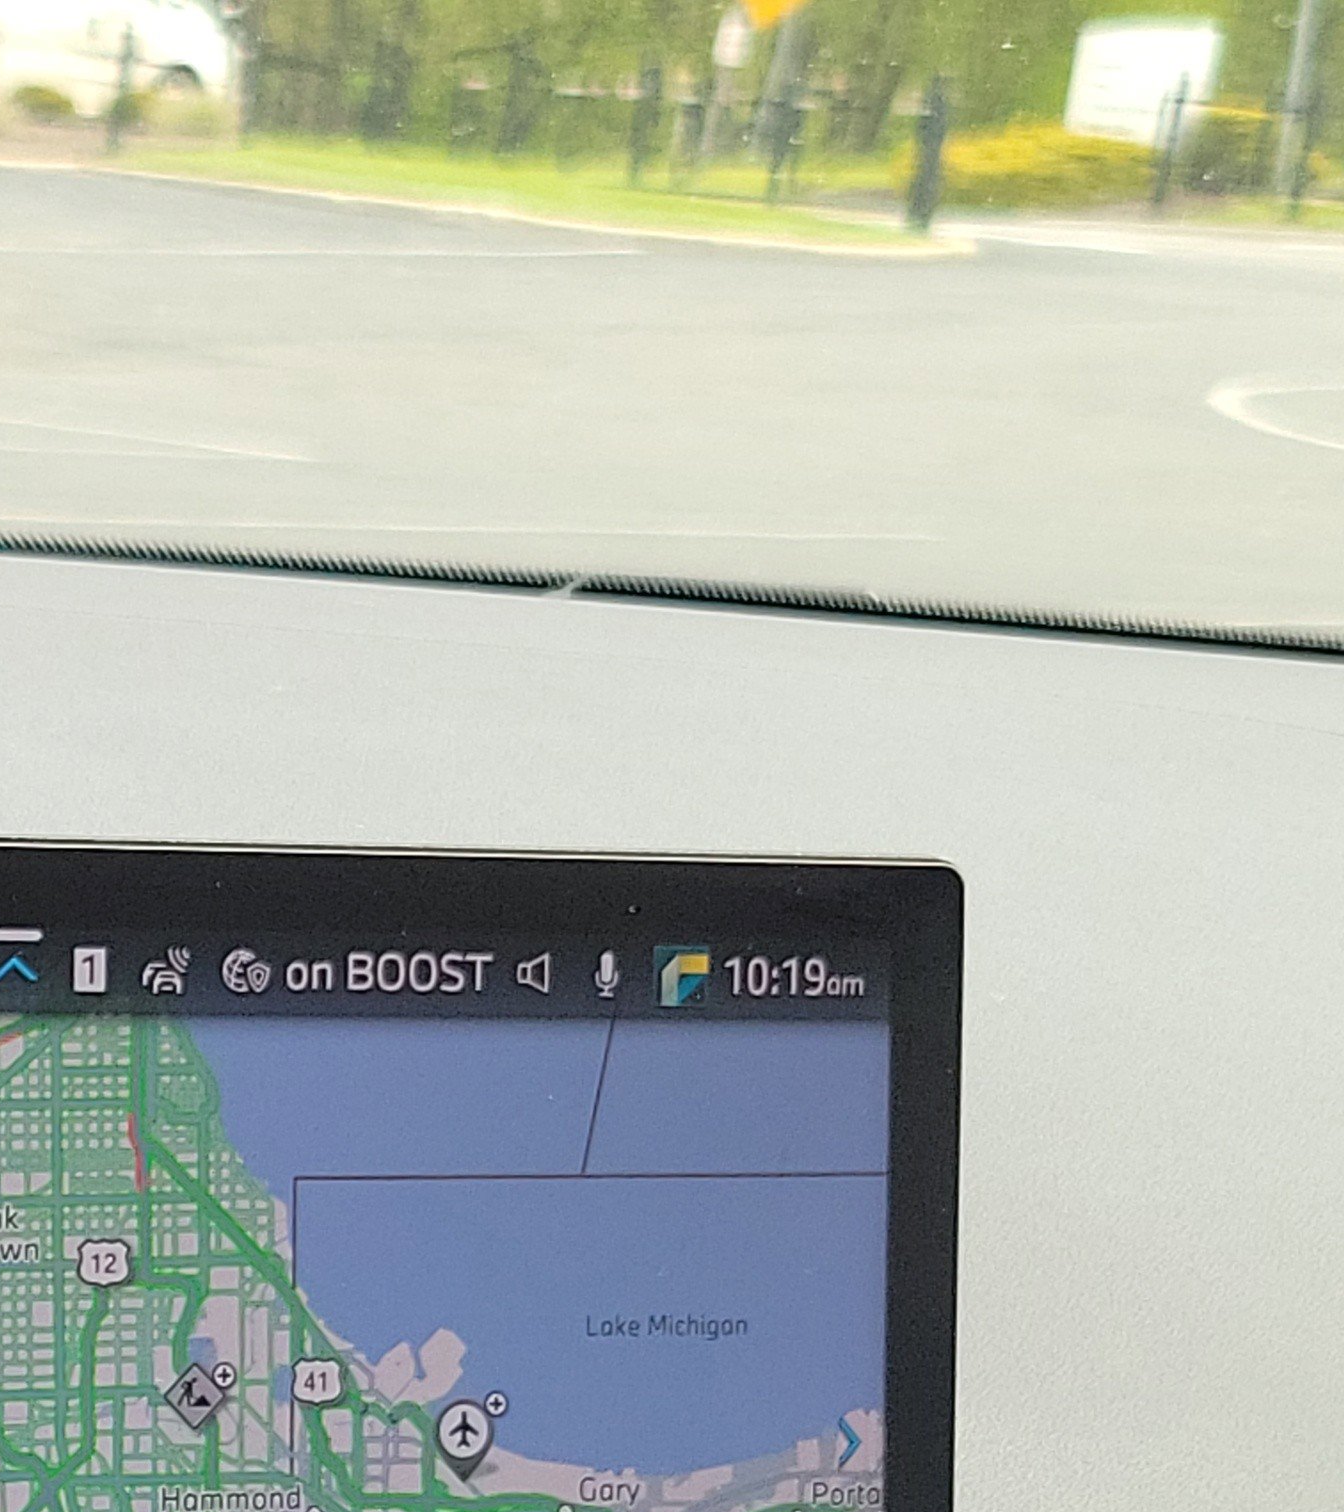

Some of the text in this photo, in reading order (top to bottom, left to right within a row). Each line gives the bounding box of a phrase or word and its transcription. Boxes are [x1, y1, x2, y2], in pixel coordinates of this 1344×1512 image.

[82, 957, 96, 986] 1
[285, 951, 493, 993] on BOOST
[724, 955, 864, 996] 10:19am
[91, 1253, 117, 1274] 12
[586, 1314, 748, 1342] Lake Michigan
[304, 1371, 328, 1392] 41
[161, 1488, 300, 1512] Hammond
[579, 1479, 640, 1506] Gary
